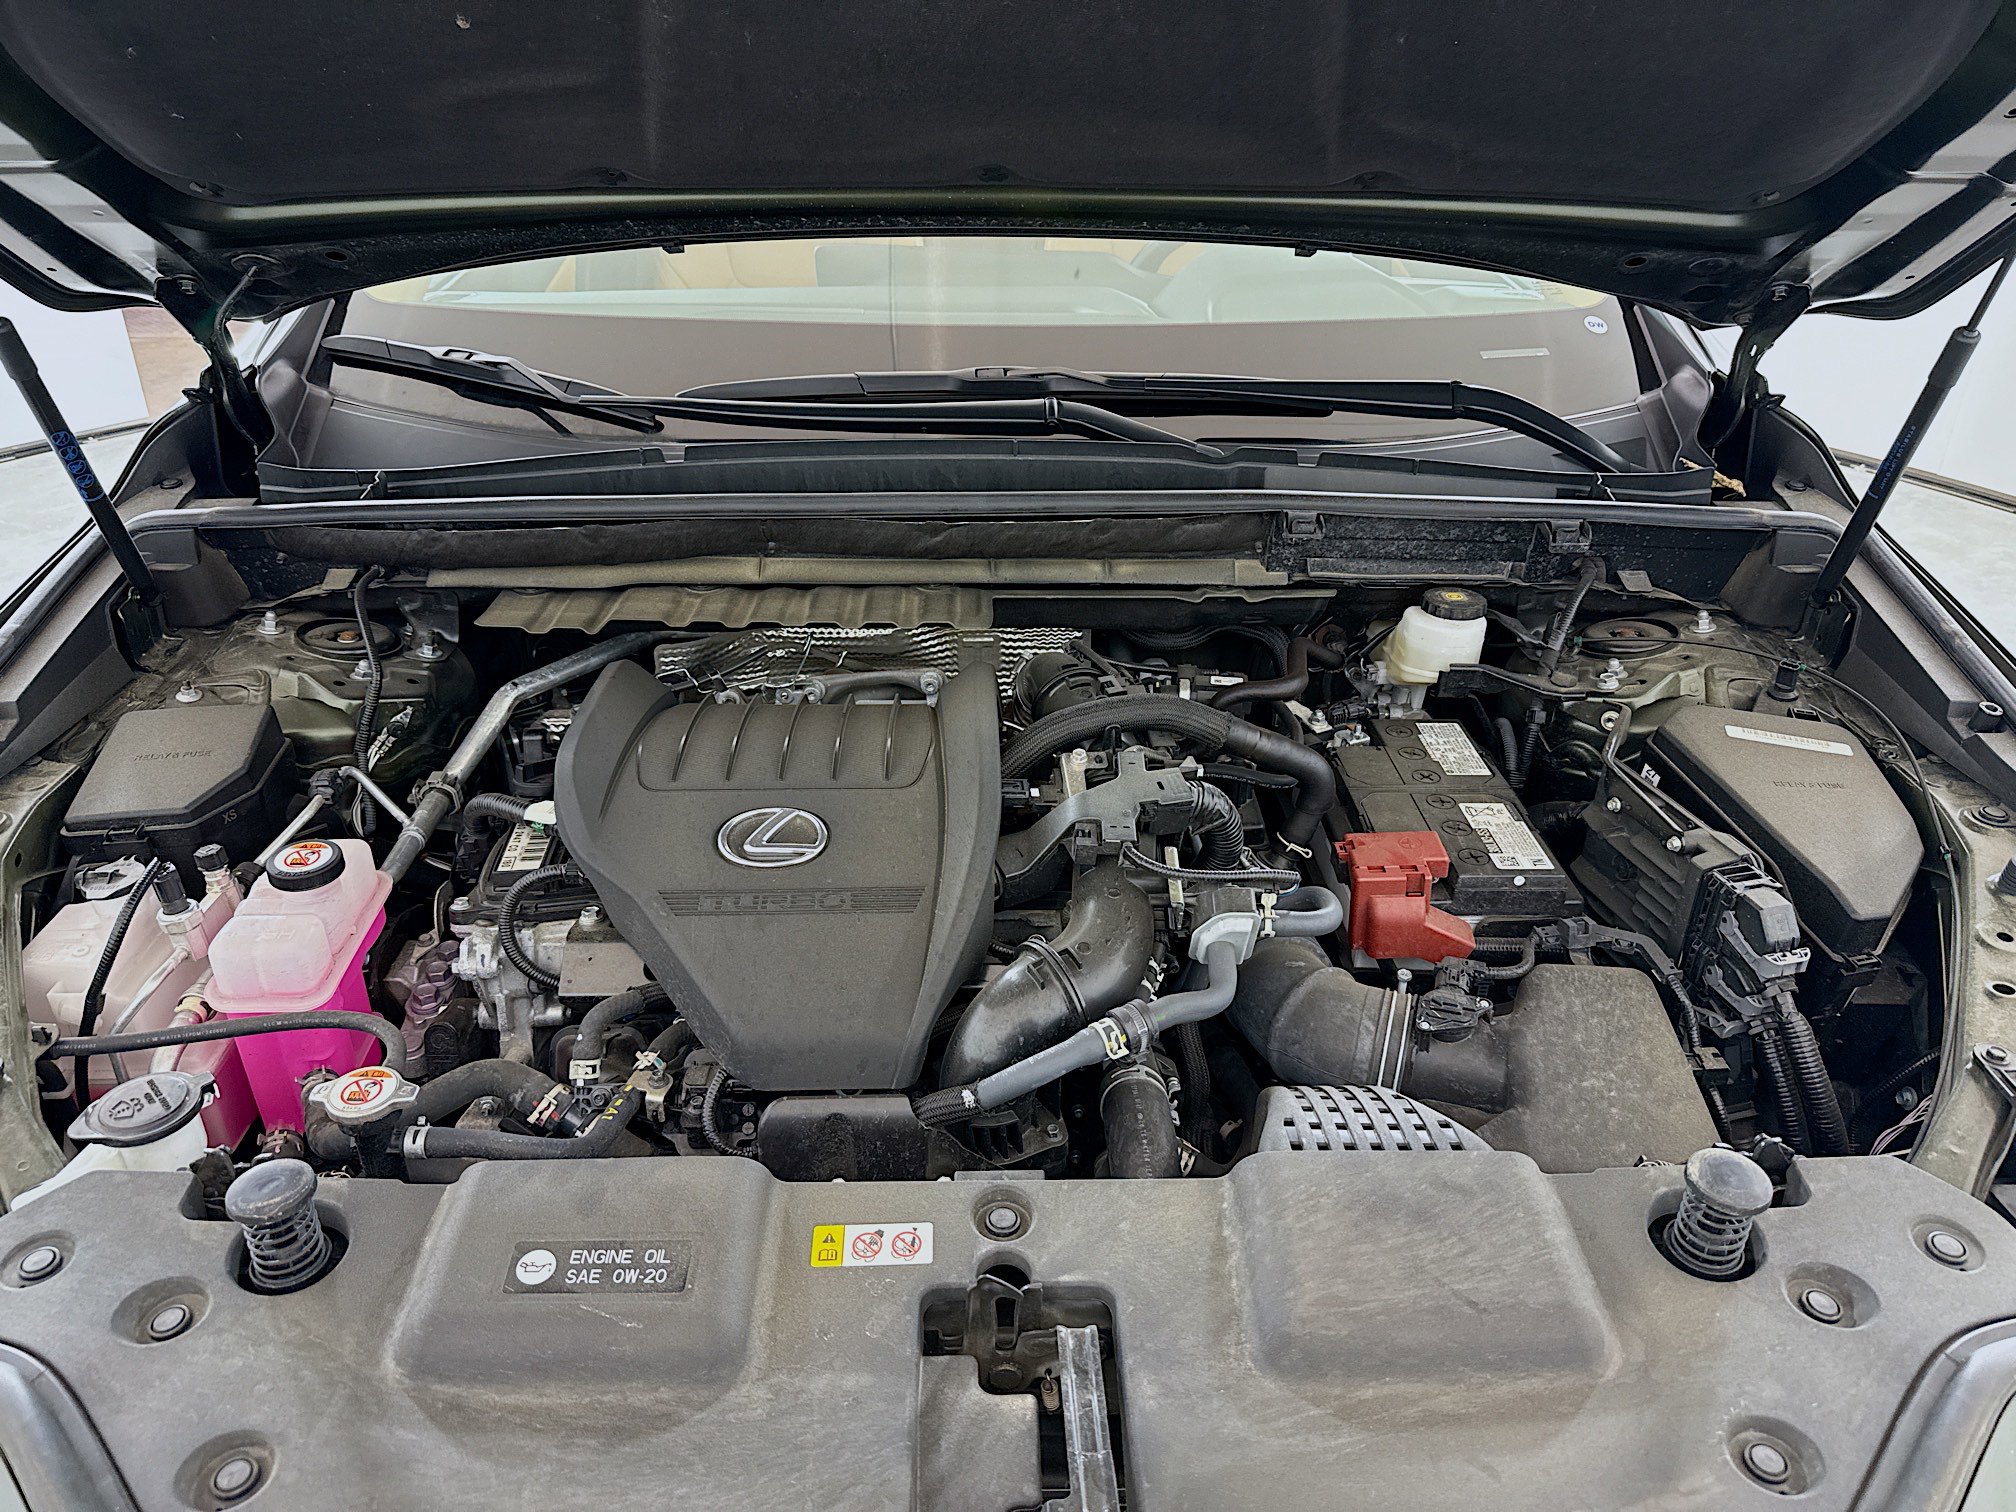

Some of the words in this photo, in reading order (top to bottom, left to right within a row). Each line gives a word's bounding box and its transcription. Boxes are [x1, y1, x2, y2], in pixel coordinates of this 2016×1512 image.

[183, 750, 212, 758] FUSE
[222, 809, 237, 824] XS
[704, 893, 847, 910] TURBO
[569, 1249, 634, 1264] ENGINE
[644, 1249, 671, 1264] OIL
[565, 1269, 602, 1284] SAE
[612, 1269, 668, 1284] 0W-20
